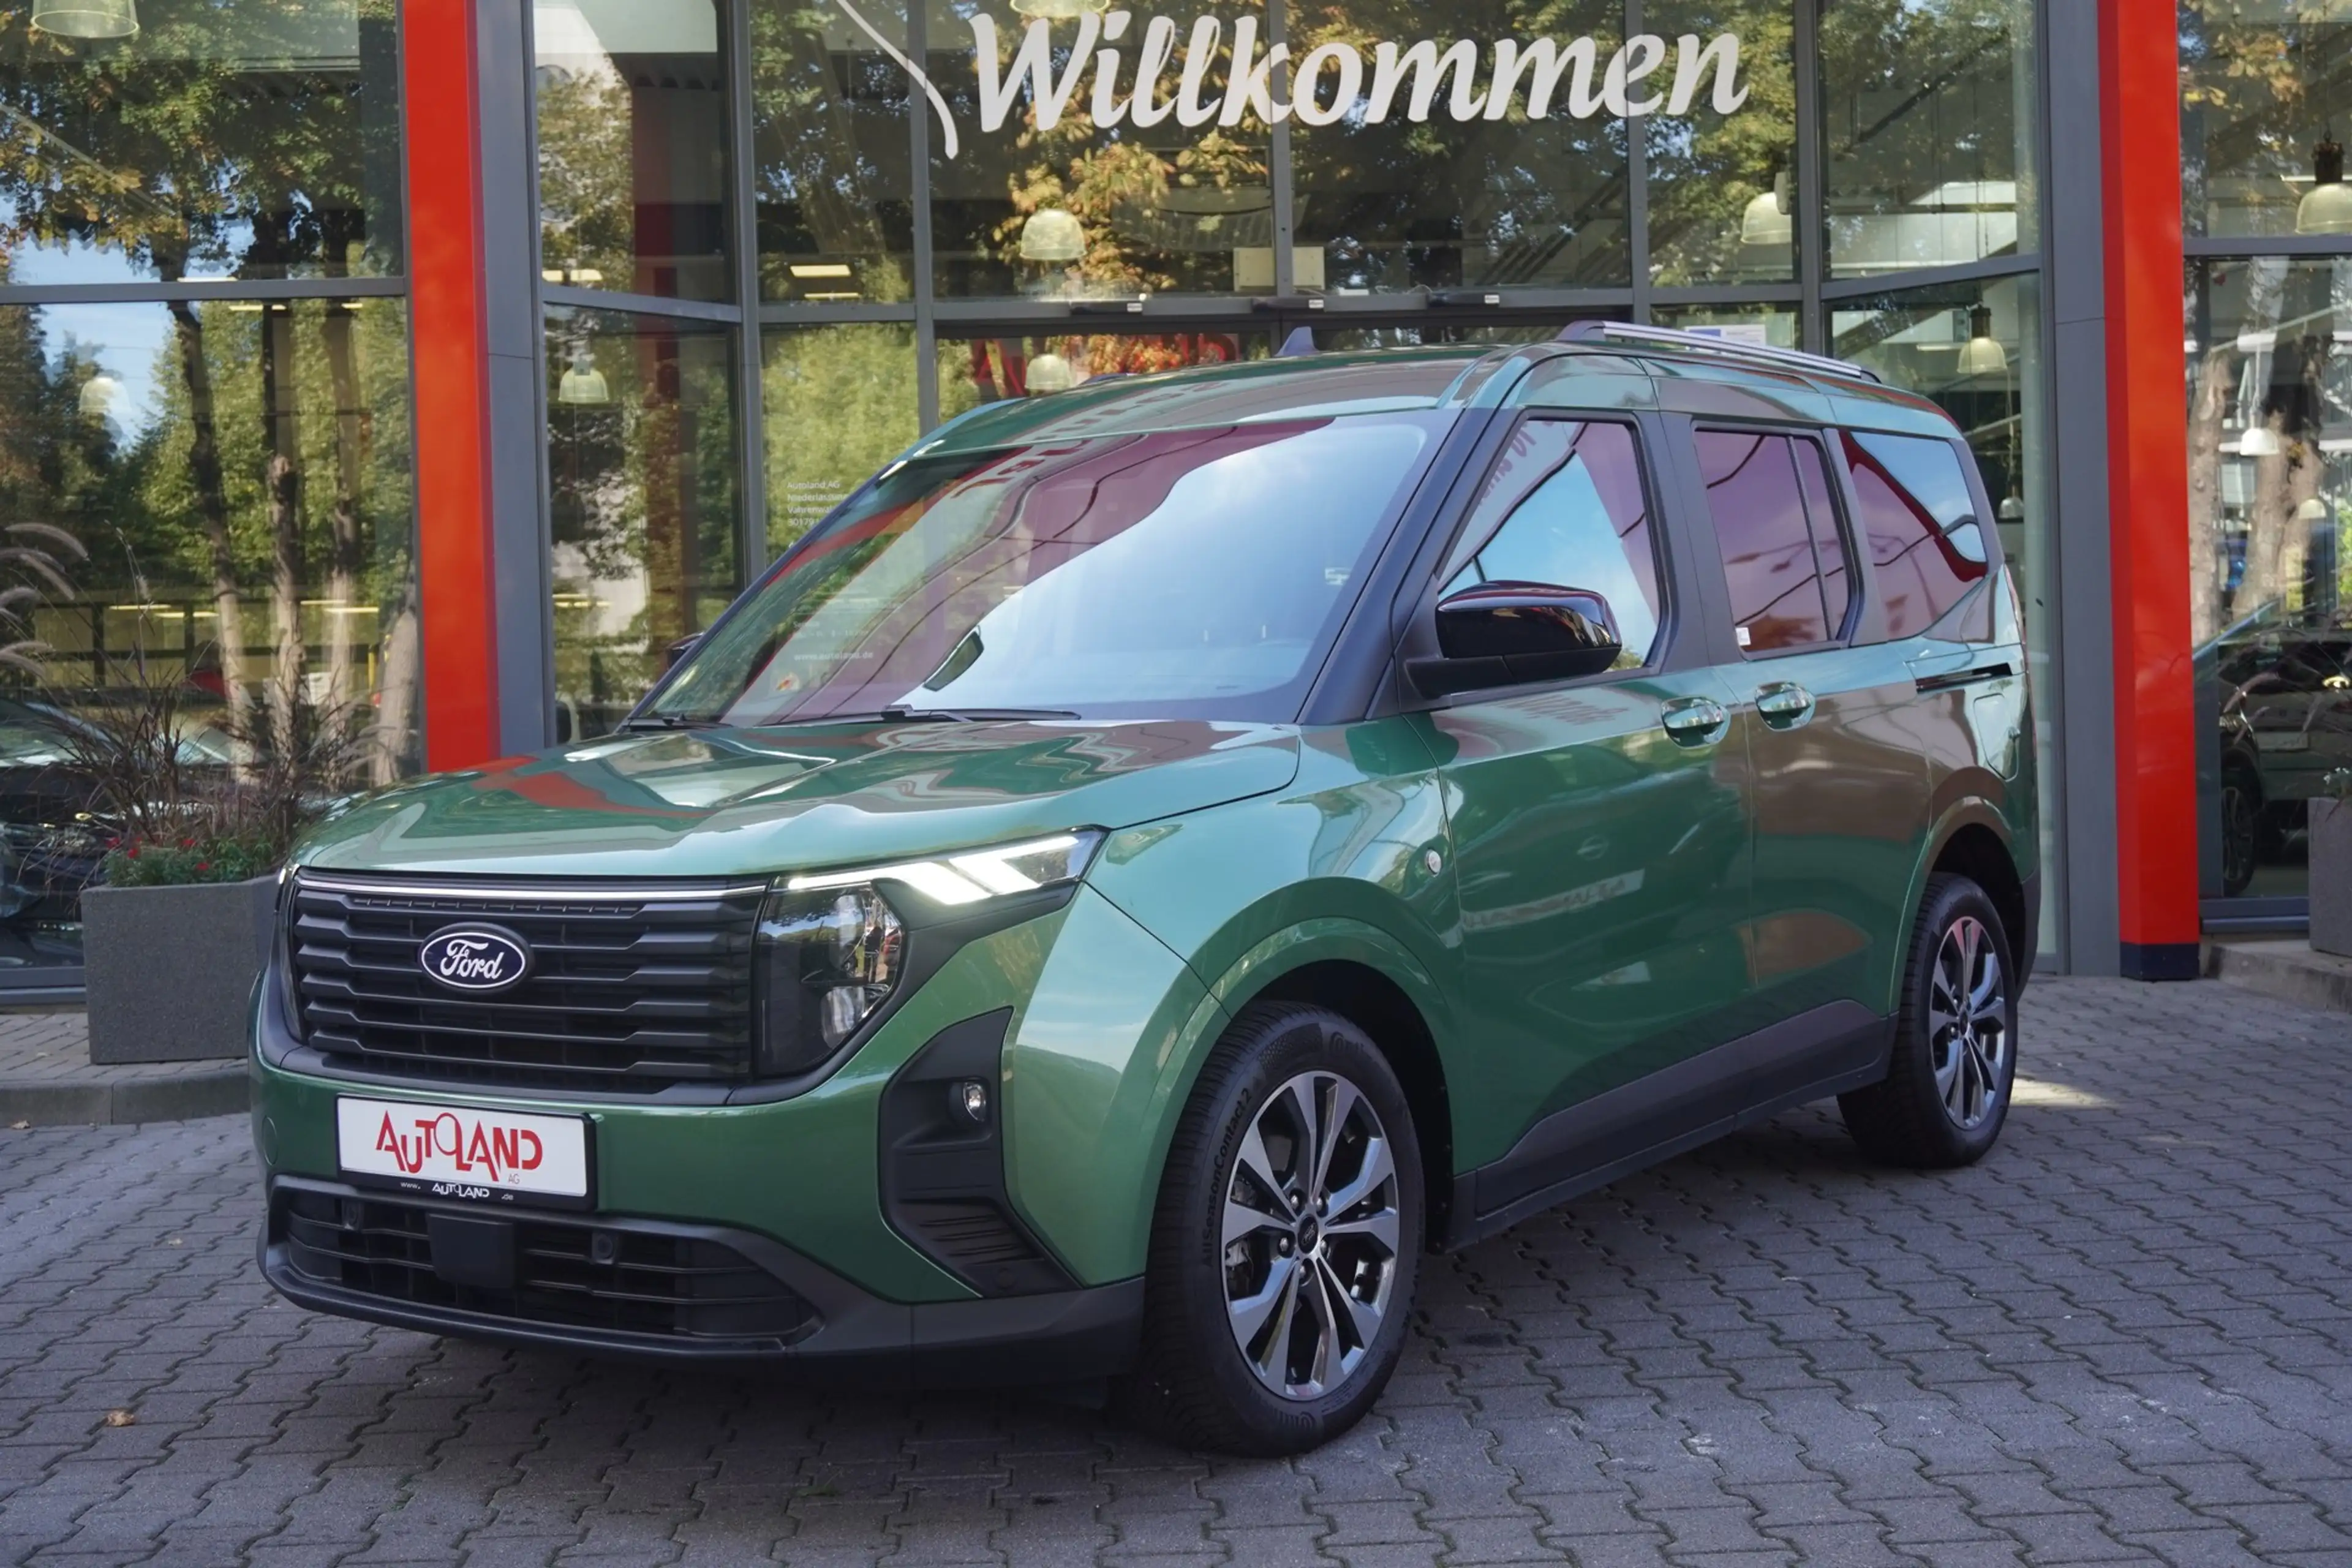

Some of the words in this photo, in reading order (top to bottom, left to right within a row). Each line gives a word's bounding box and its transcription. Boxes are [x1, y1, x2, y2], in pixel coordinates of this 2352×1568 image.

[968, 10, 1749, 133] Willkommen
[787, 480, 826, 489] Autoland
[440, 939, 505, 979] Ford
[508, 1174, 521, 1185] AG
[401, 1182, 421, 1190] www.
